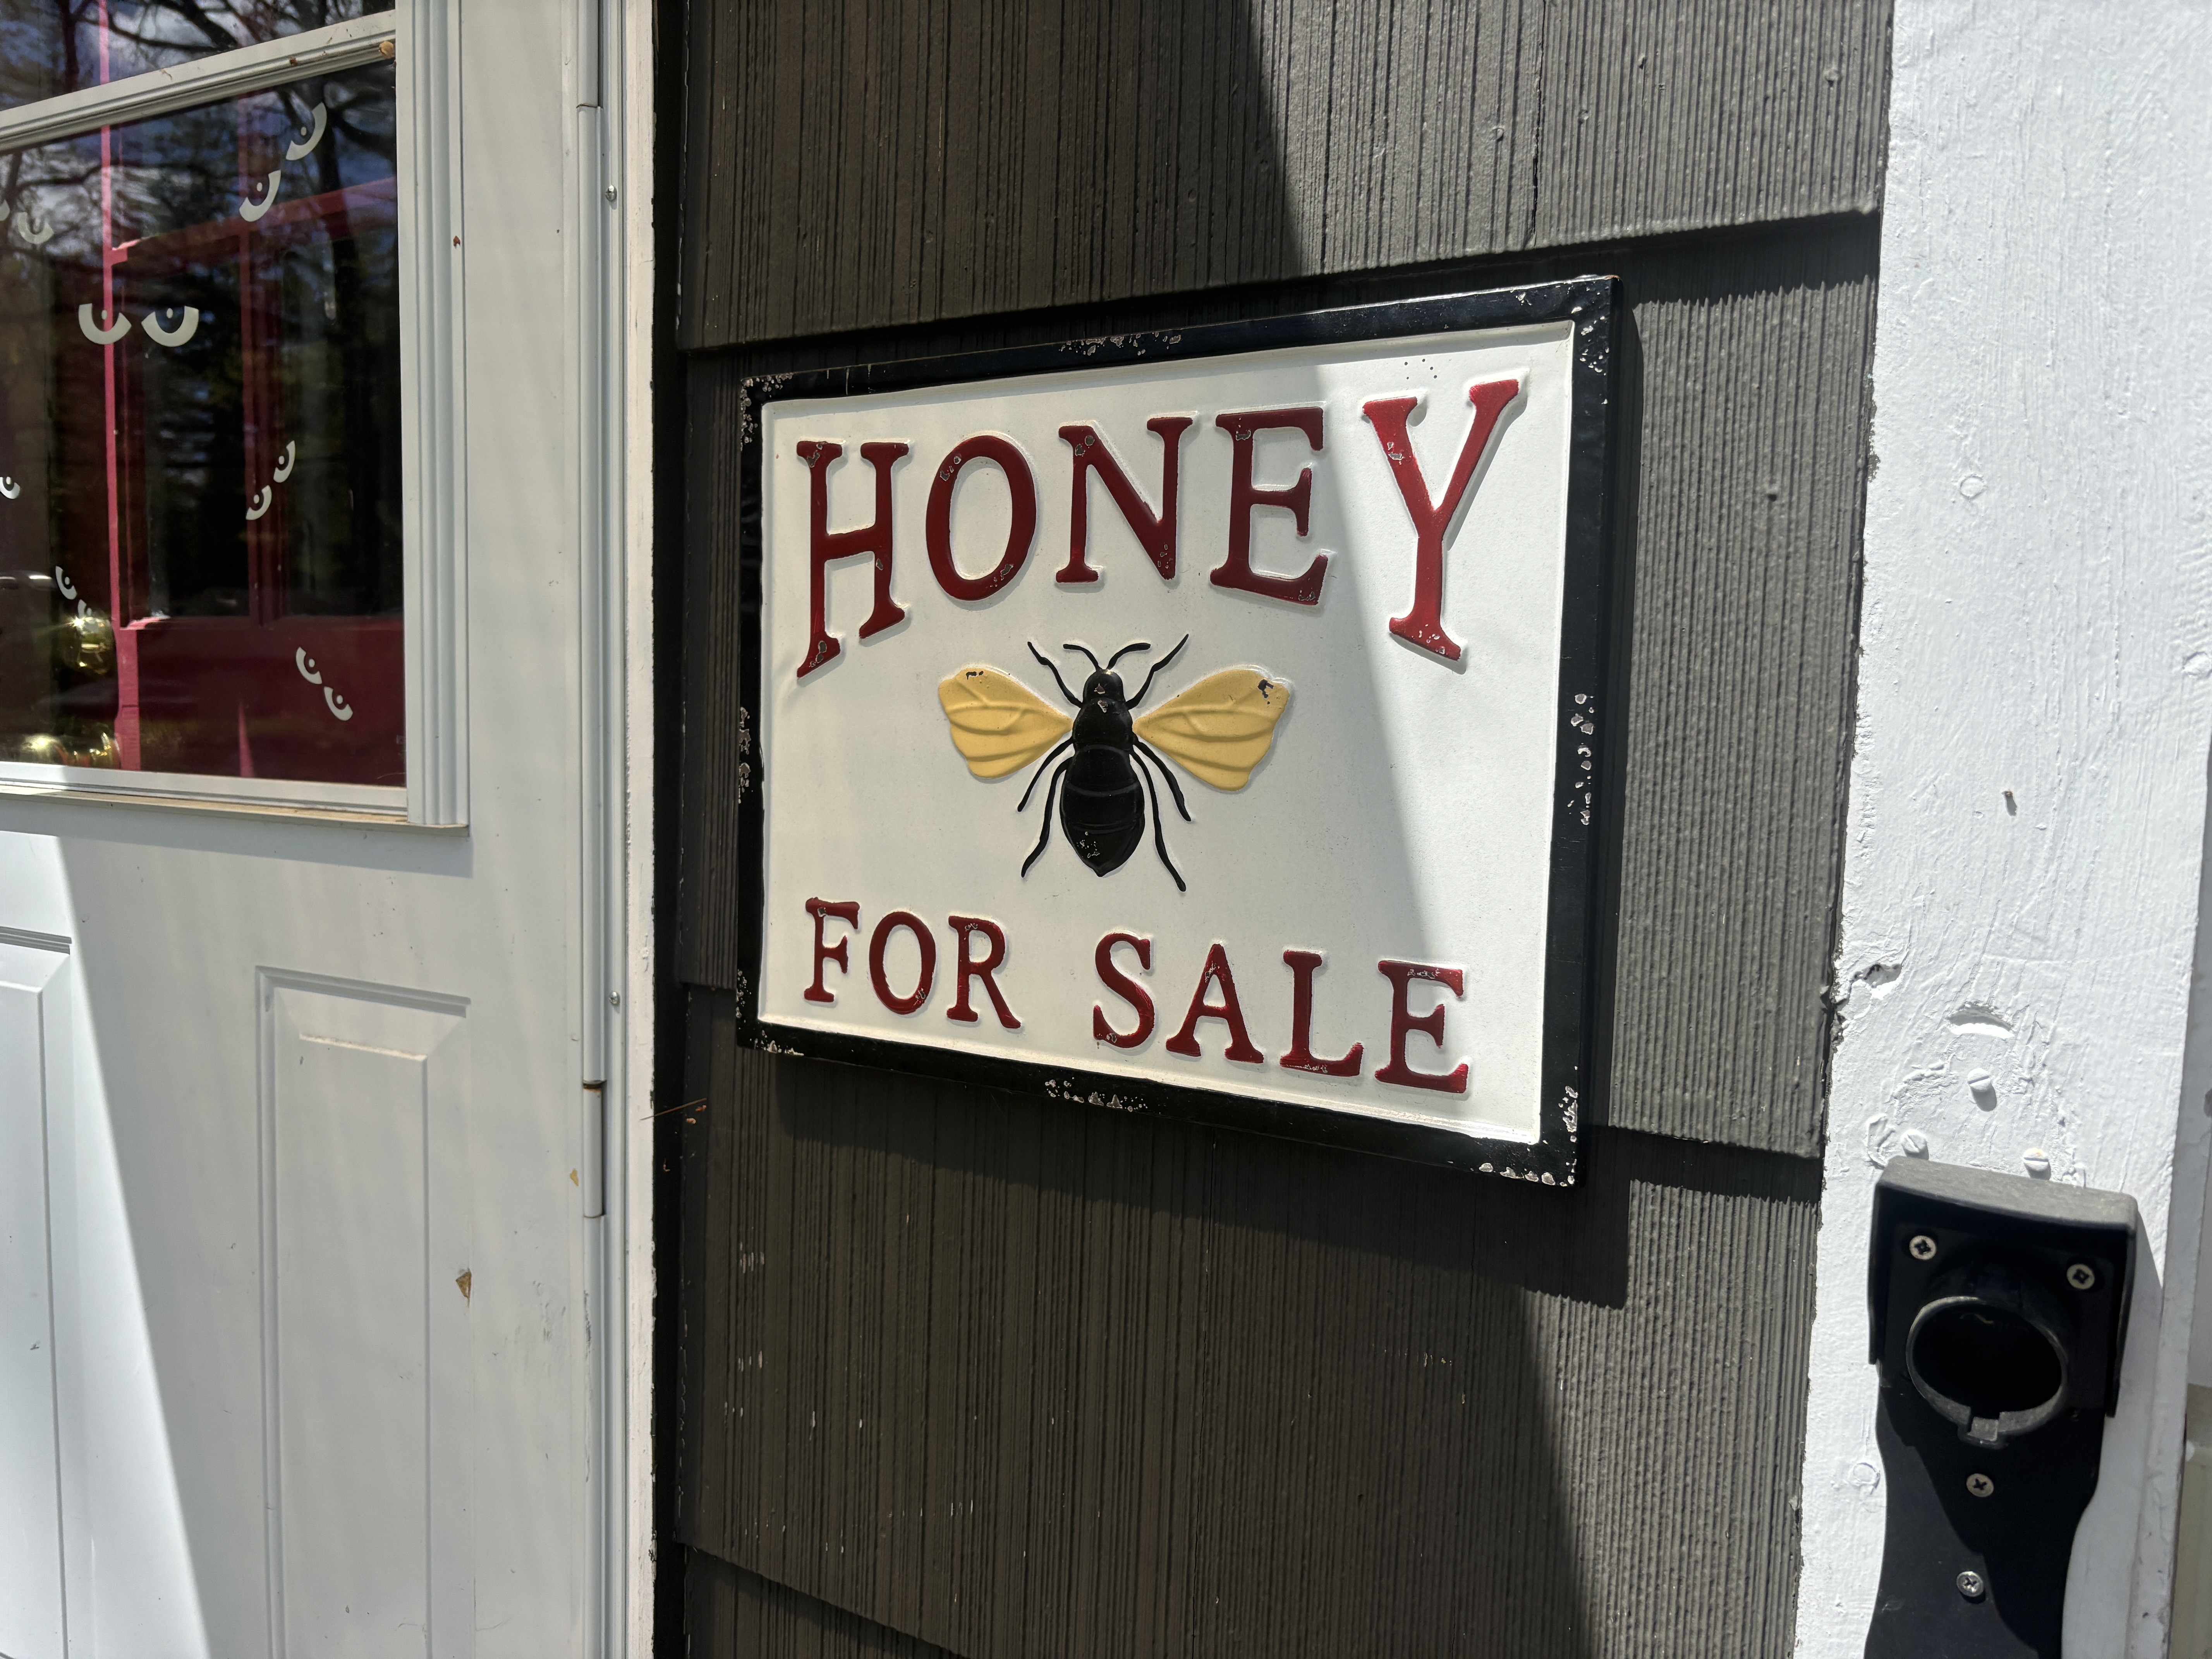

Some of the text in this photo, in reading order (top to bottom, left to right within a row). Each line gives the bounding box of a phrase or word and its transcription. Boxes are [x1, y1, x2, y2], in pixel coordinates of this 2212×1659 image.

[796, 379, 1520, 678] HONEY
[804, 897, 1470, 1094] FOR SALE
